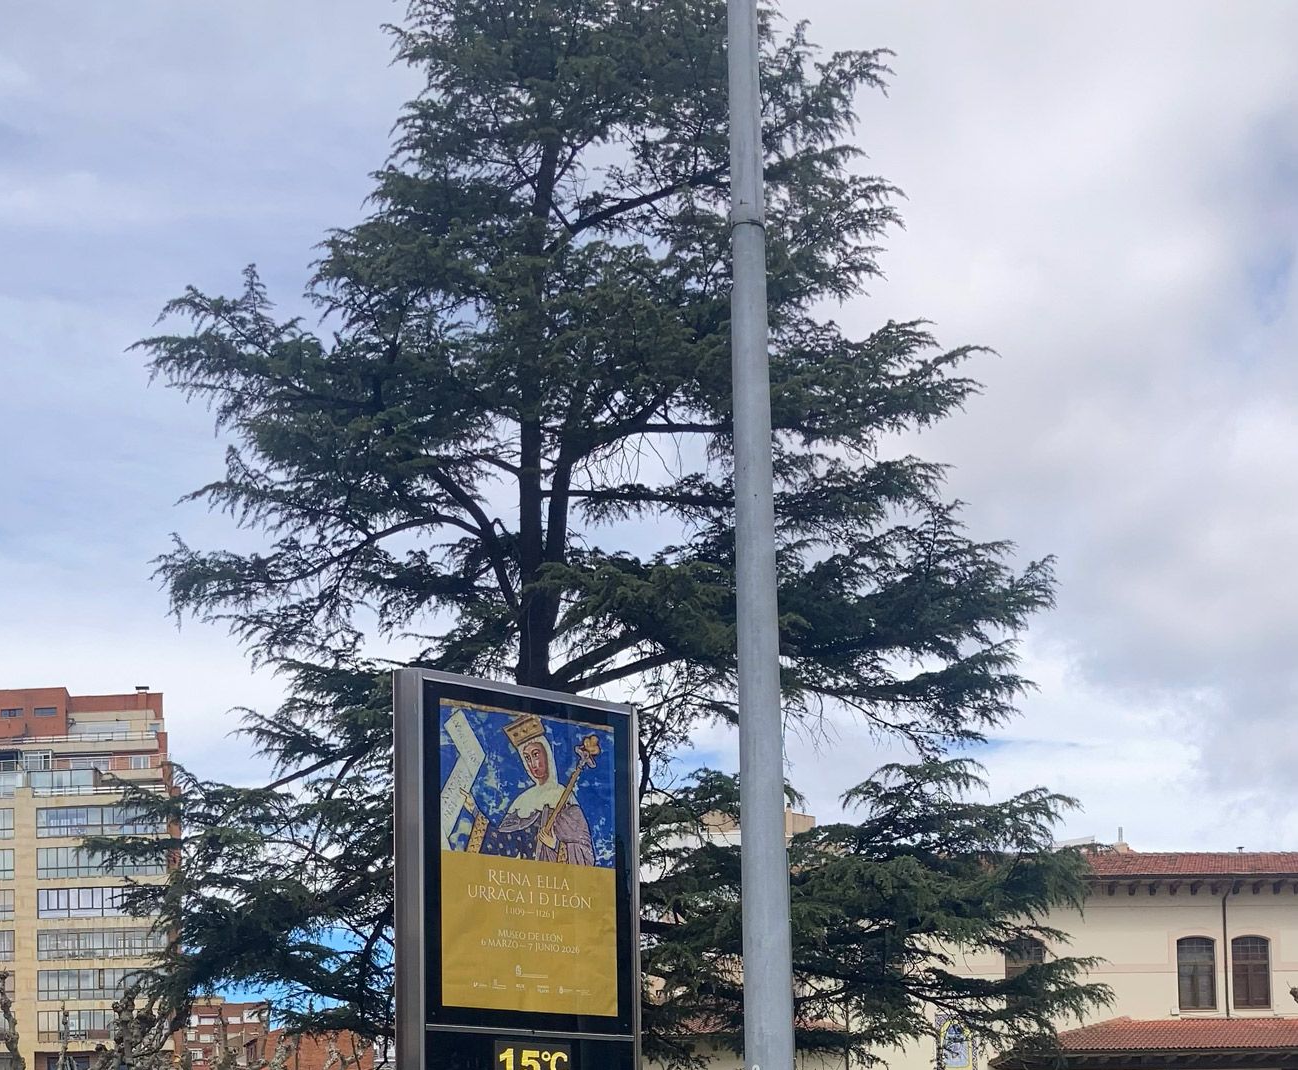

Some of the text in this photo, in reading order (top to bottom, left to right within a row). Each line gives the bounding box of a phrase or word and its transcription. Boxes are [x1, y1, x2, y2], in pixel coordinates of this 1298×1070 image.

[488, 869, 569, 890] REINA ELLA
[468, 884, 525, 903] URRACA
[554, 892, 591, 909] LEÓN
[498, 929, 563, 943] MUSEO DE LEÓN
[487, 939, 519, 949] MARZO
[535, 942, 560, 953] JUNIO
